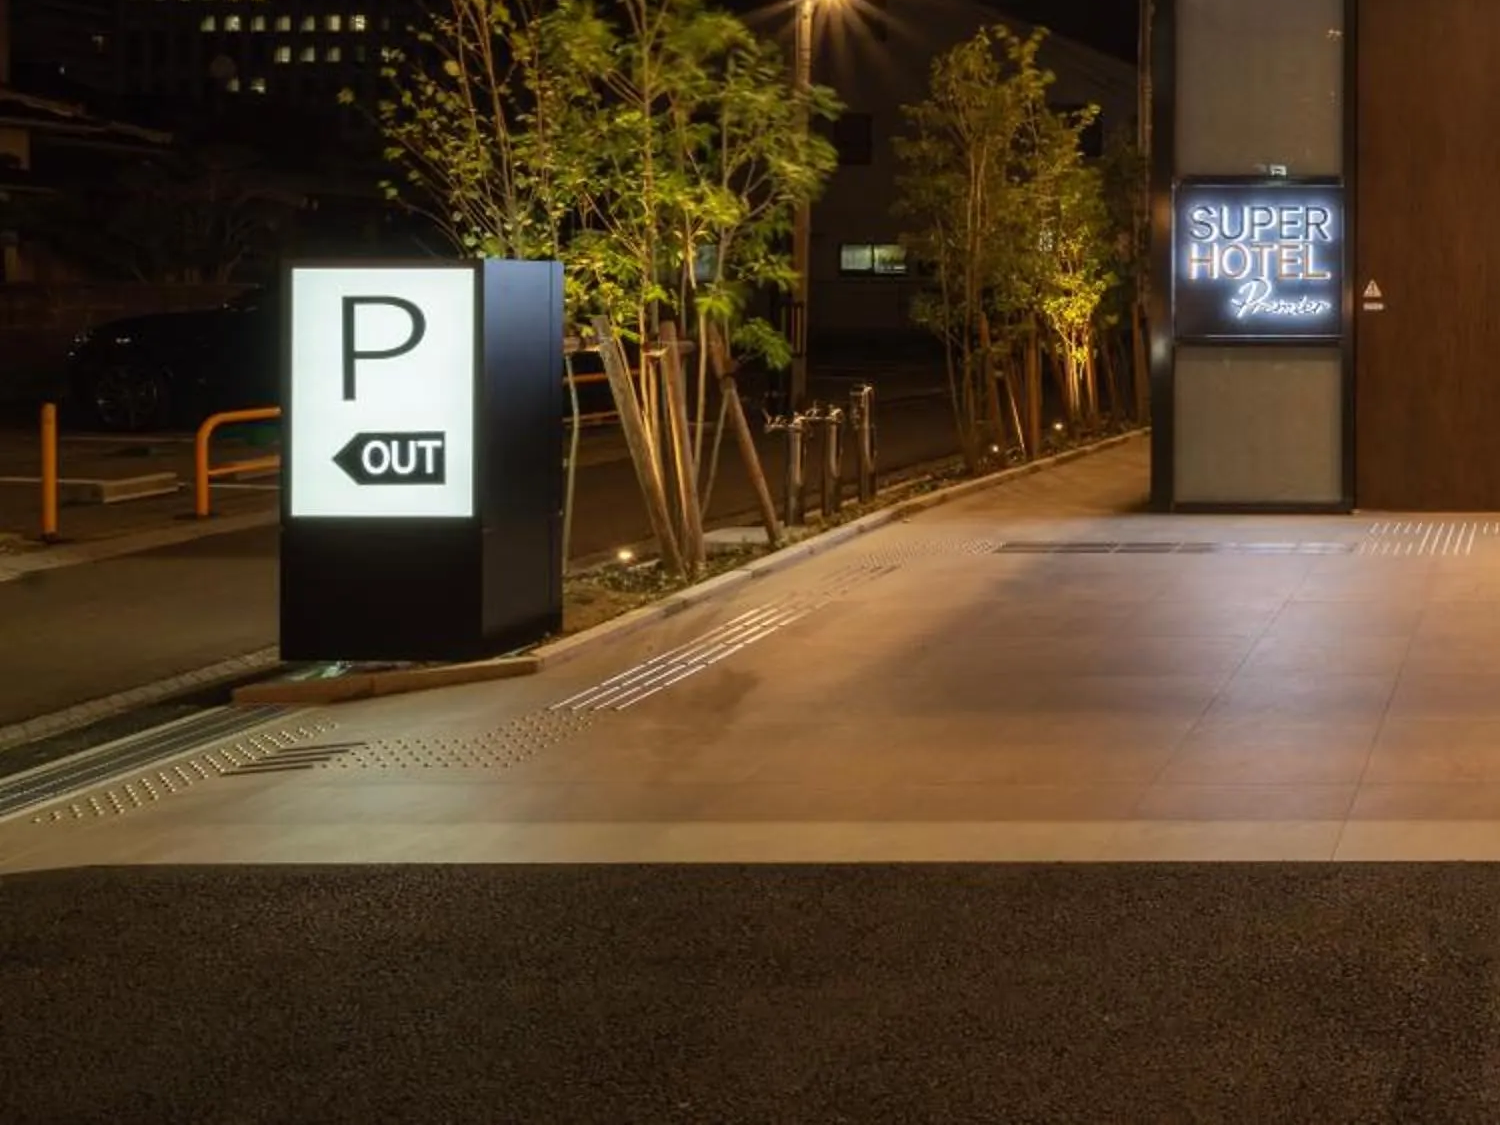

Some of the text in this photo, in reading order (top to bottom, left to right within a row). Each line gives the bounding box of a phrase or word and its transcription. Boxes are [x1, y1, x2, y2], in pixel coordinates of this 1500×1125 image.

[1189, 205, 1332, 242] SUPER
[1188, 242, 1332, 280] HOTEL
[341, 295, 427, 401] P
[361, 439, 443, 475] OUT
